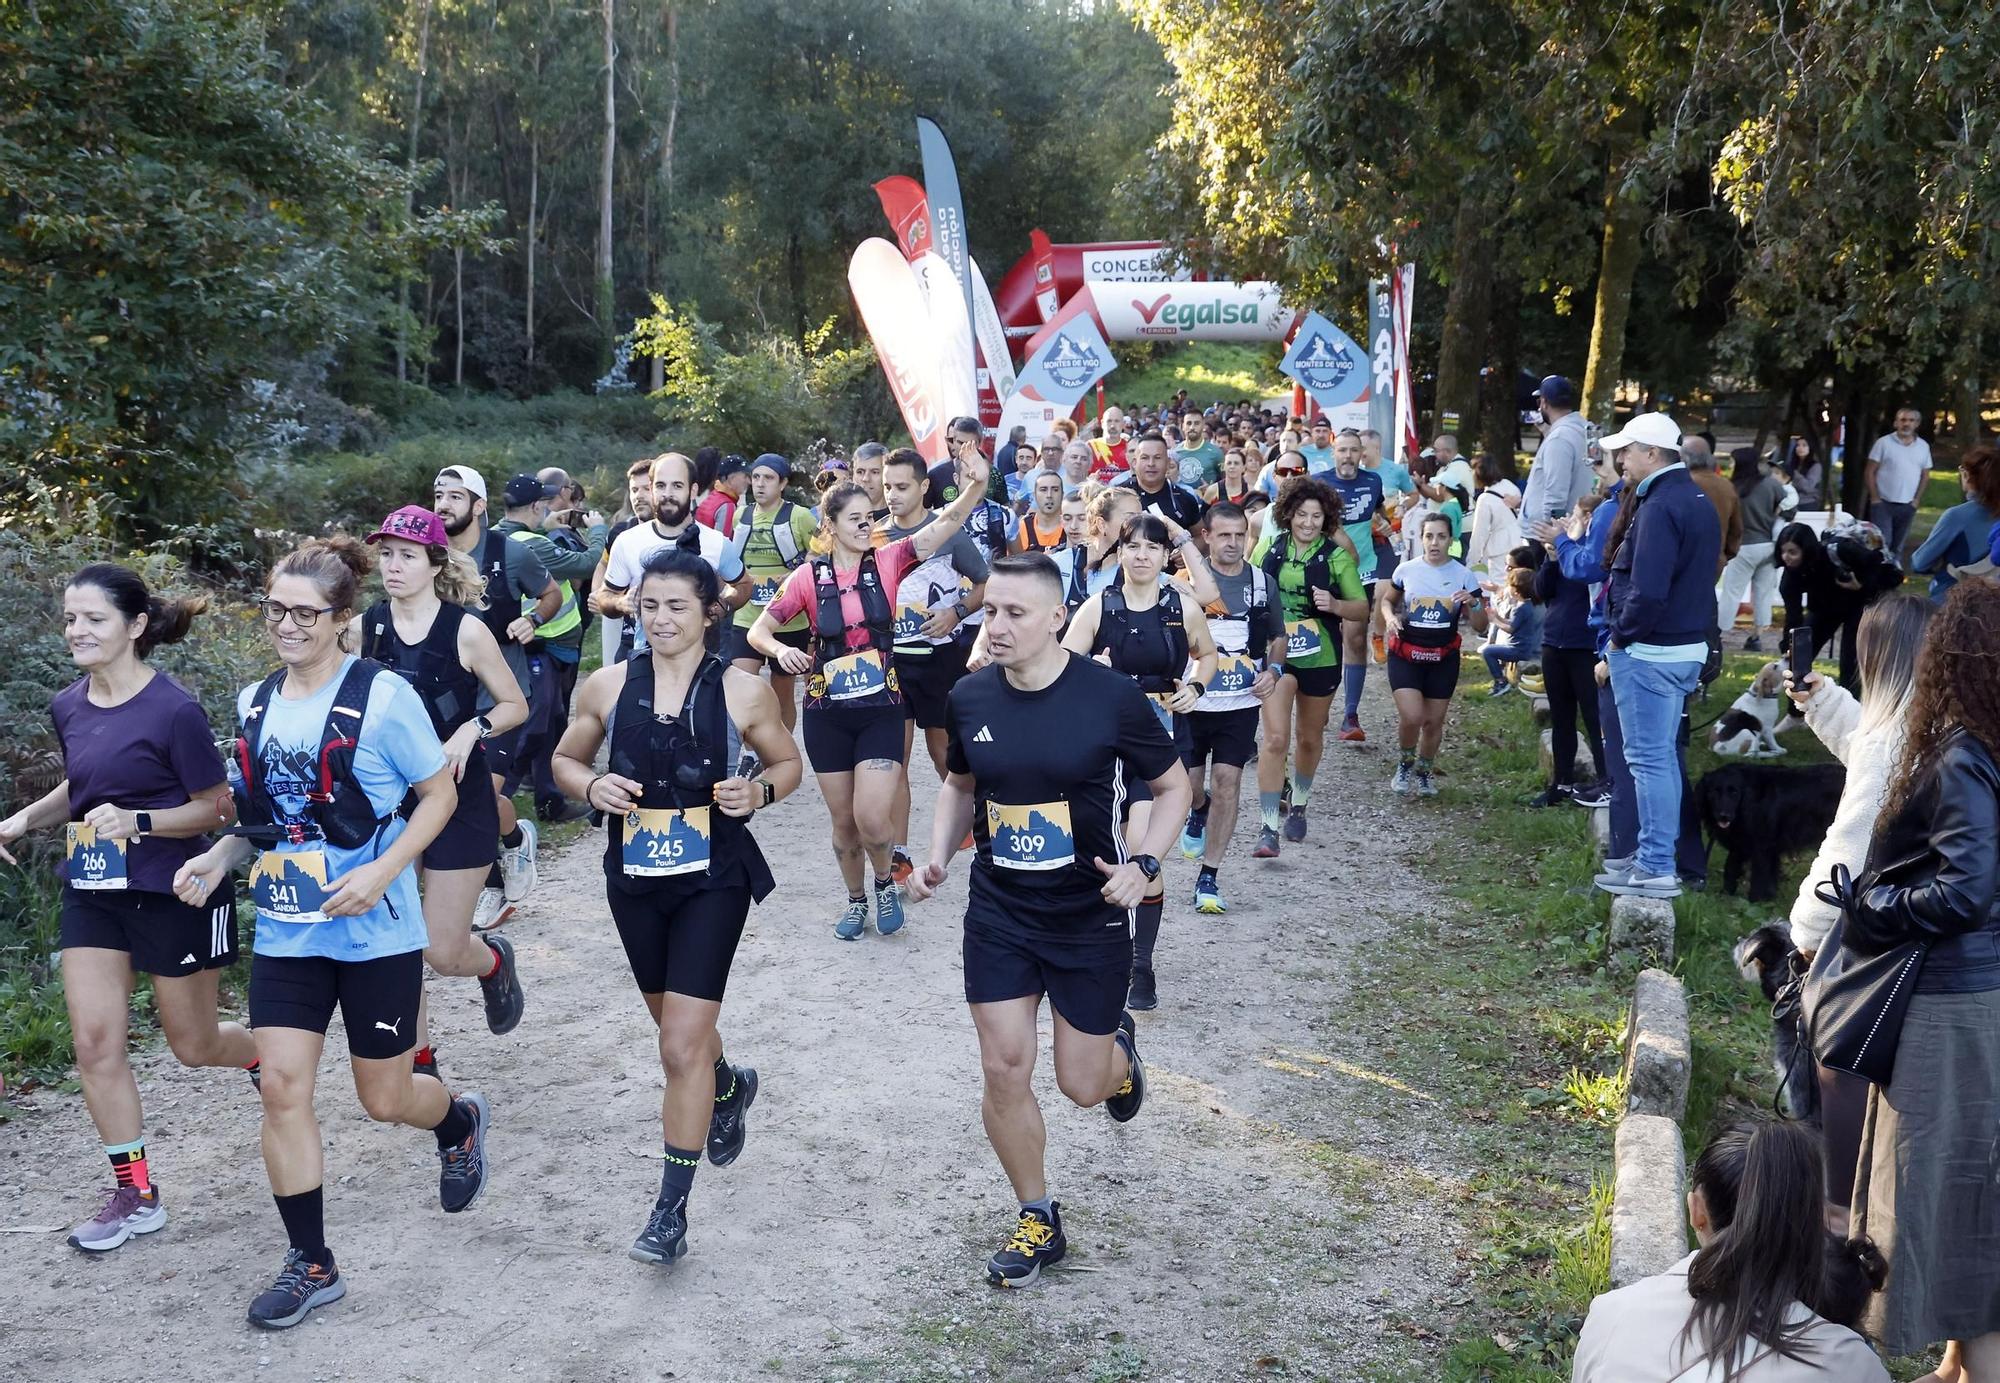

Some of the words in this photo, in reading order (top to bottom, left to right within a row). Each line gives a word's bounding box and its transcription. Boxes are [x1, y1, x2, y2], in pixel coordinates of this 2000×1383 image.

[1131, 293, 1258, 331] Vegalsa
[1043, 360, 1072, 369] MONTES
[1083, 359, 1100, 367] VIGO
[1295, 360, 1324, 368] MONTES
[1325, 360, 1335, 368] DE
[1336, 360, 1353, 370] VIGO
[1060, 379, 1083, 387] TRAIL
[1311, 380, 1335, 388] TRAIL
[757, 588, 775, 598] 235
[1421, 610, 1441, 620] 469
[894, 620, 916, 633] 312
[1287, 636, 1308, 648] 422
[844, 671, 869, 687] 414
[1222, 673, 1243, 686] 323
[646, 839, 684, 858] 245
[1009, 834, 1046, 853] 309
[81, 852, 107, 871] 266
[655, 858, 676, 867] Paula
[1022, 853, 1036, 861] Luis
[268, 883, 299, 904] 341
[272, 903, 301, 913] SANDRA
